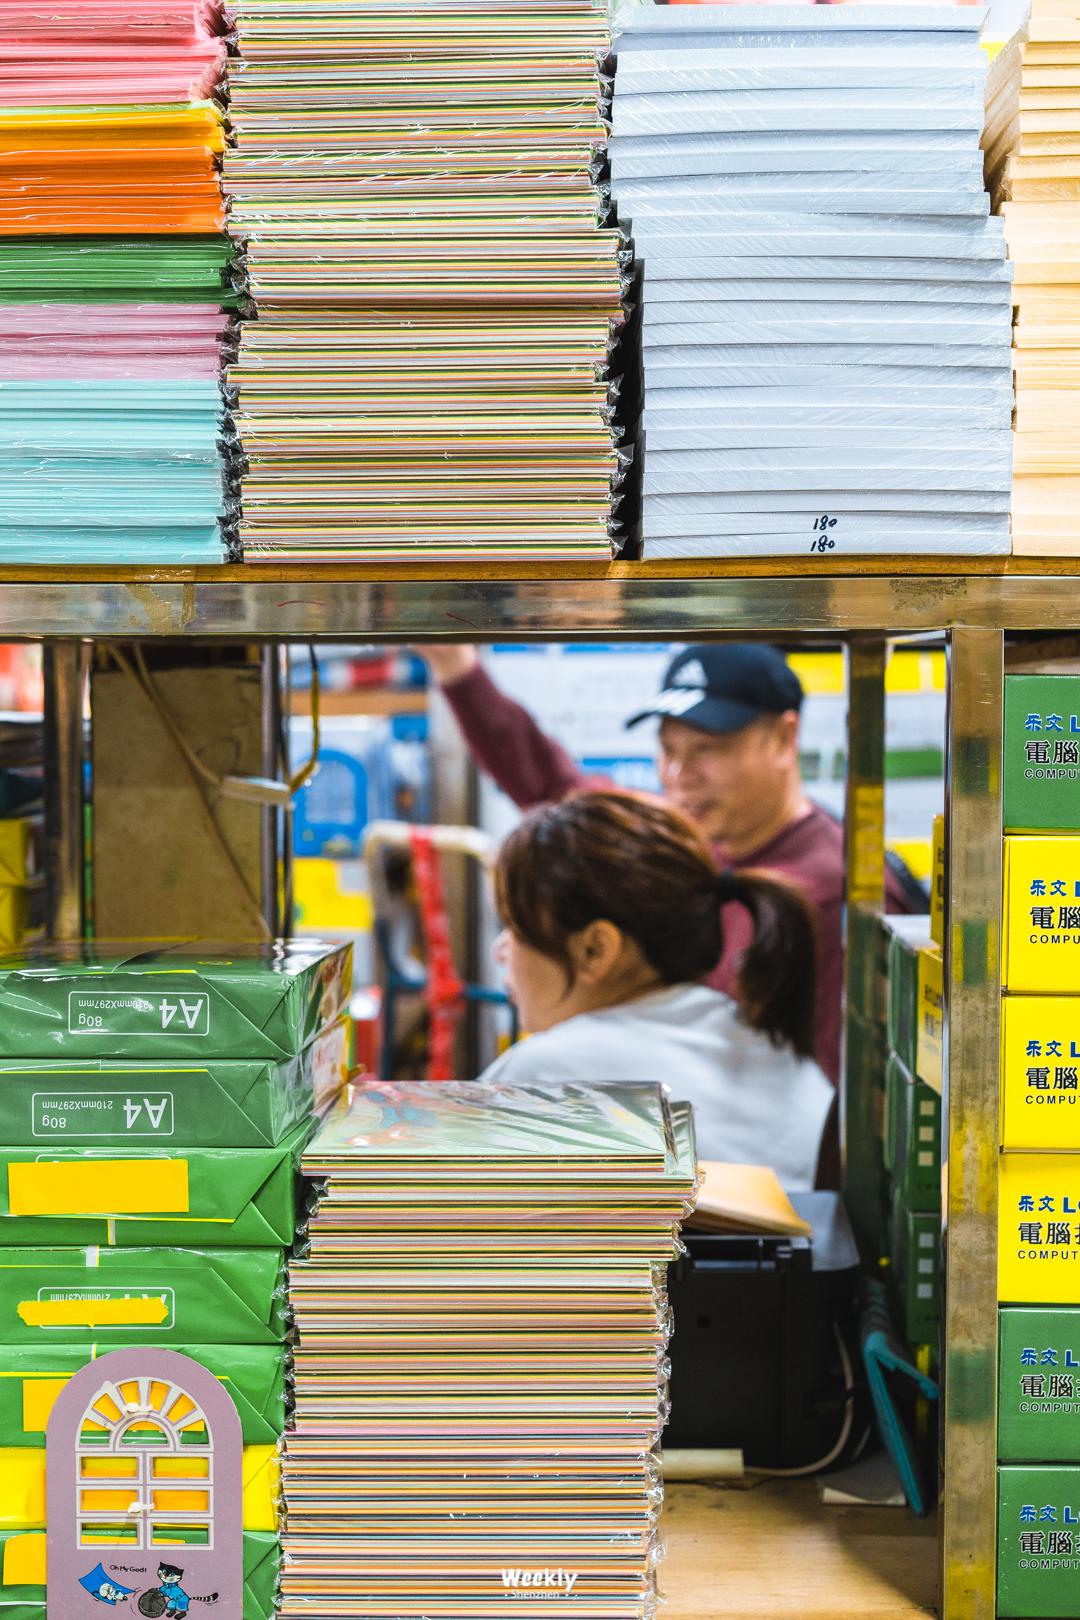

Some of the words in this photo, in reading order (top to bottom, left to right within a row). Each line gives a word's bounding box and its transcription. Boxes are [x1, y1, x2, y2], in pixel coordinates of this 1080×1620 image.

[813, 515, 838, 531] 180
[810, 534, 835, 552] 180
[1025, 740, 1079, 764] 電腦
[1030, 906, 1080, 929] 電腦
[1030, 935, 1080, 944] COMPU
[79, 1013, 103, 1027] 80g
[159, 999, 203, 1029] A4
[1026, 1067, 1078, 1090] 電腦
[42, 1100, 113, 1110] 210mmX297mm
[1025, 1095, 1080, 1105] COMPU
[123, 1098, 167, 1128] A4
[42, 1115, 66, 1128] 80g
[1063, 1197, 1080, 1213] L
[1018, 1250, 1079, 1260] COMPUT
[1020, 1374, 1080, 1398] 電腦
[1020, 1402, 1080, 1412] COMPUT
[1064, 1506, 1080, 1523] L
[1020, 1531, 1080, 1555] 電腦
[1019, 1559, 1080, 1569] COMPUT
